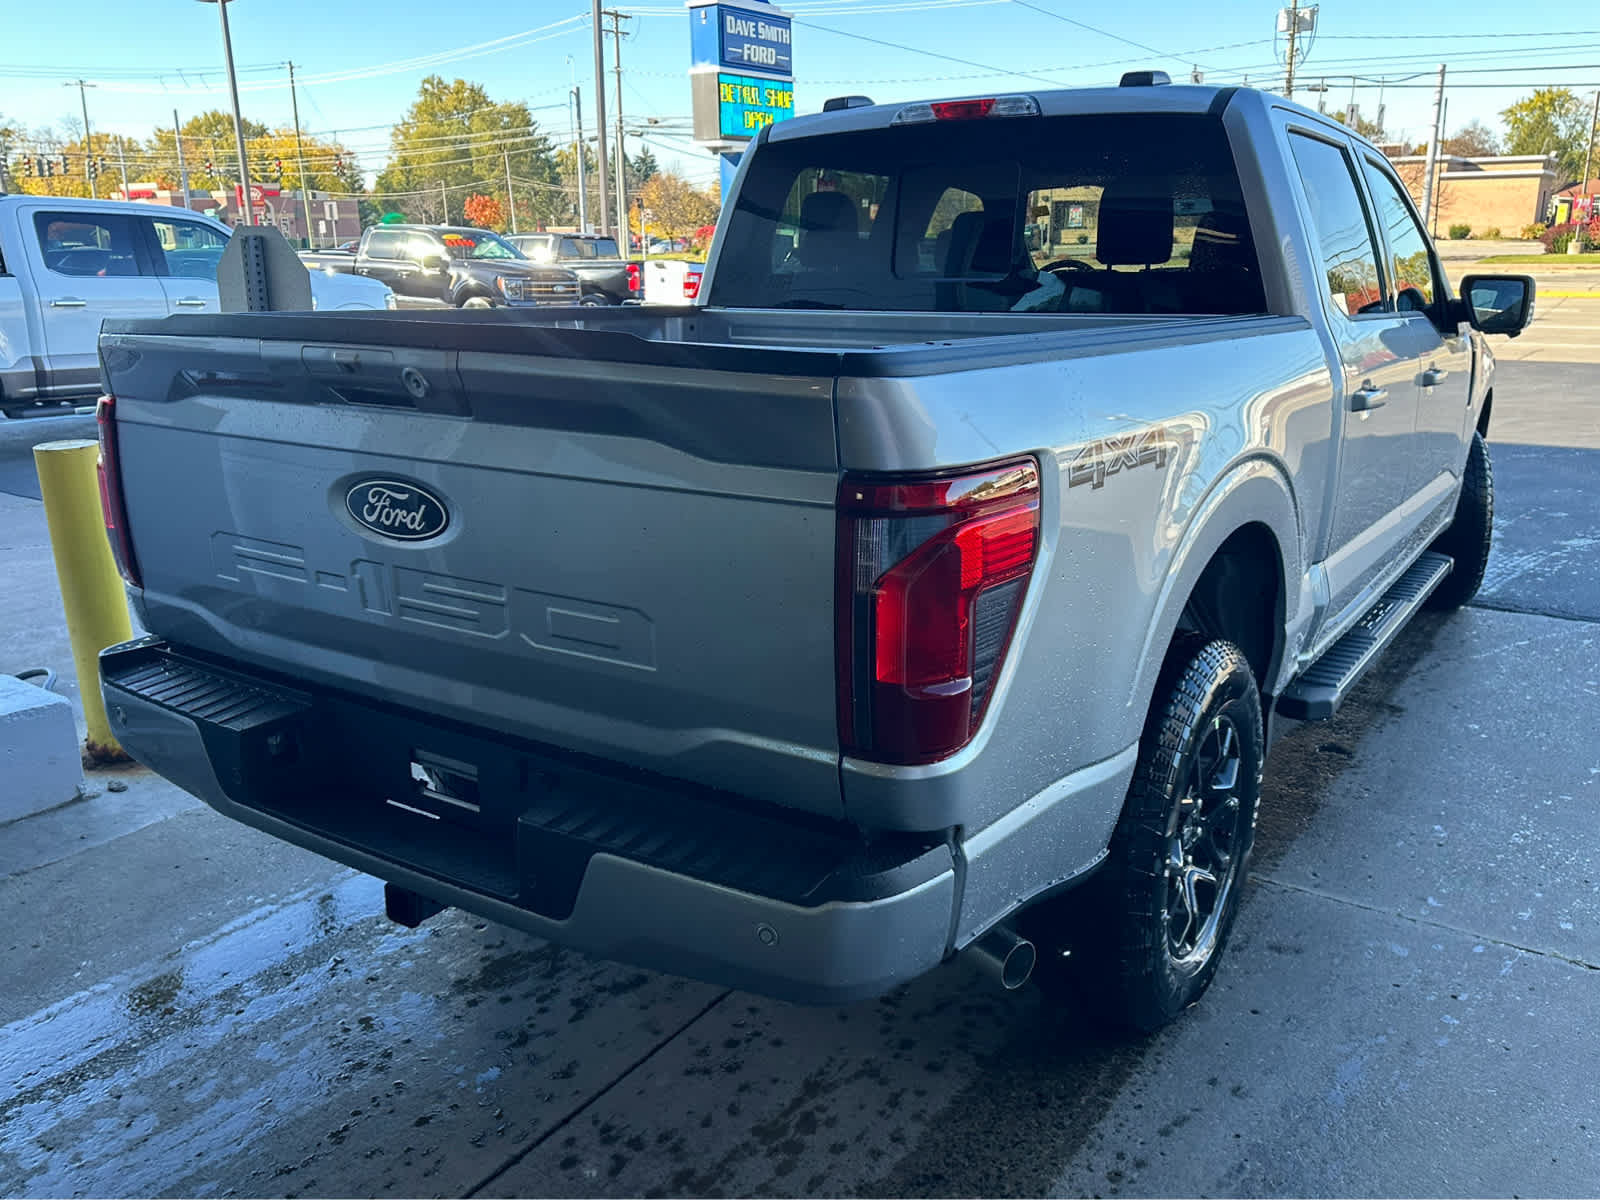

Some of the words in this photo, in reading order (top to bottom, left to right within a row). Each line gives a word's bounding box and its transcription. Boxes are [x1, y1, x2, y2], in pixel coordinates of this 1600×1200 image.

[726, 15, 757, 39] DAVE
[758, 21, 790, 44] SMITH
[743, 43, 776, 65] FORD
[362, 486, 427, 532] Ford
[210, 530, 657, 672] F-150
